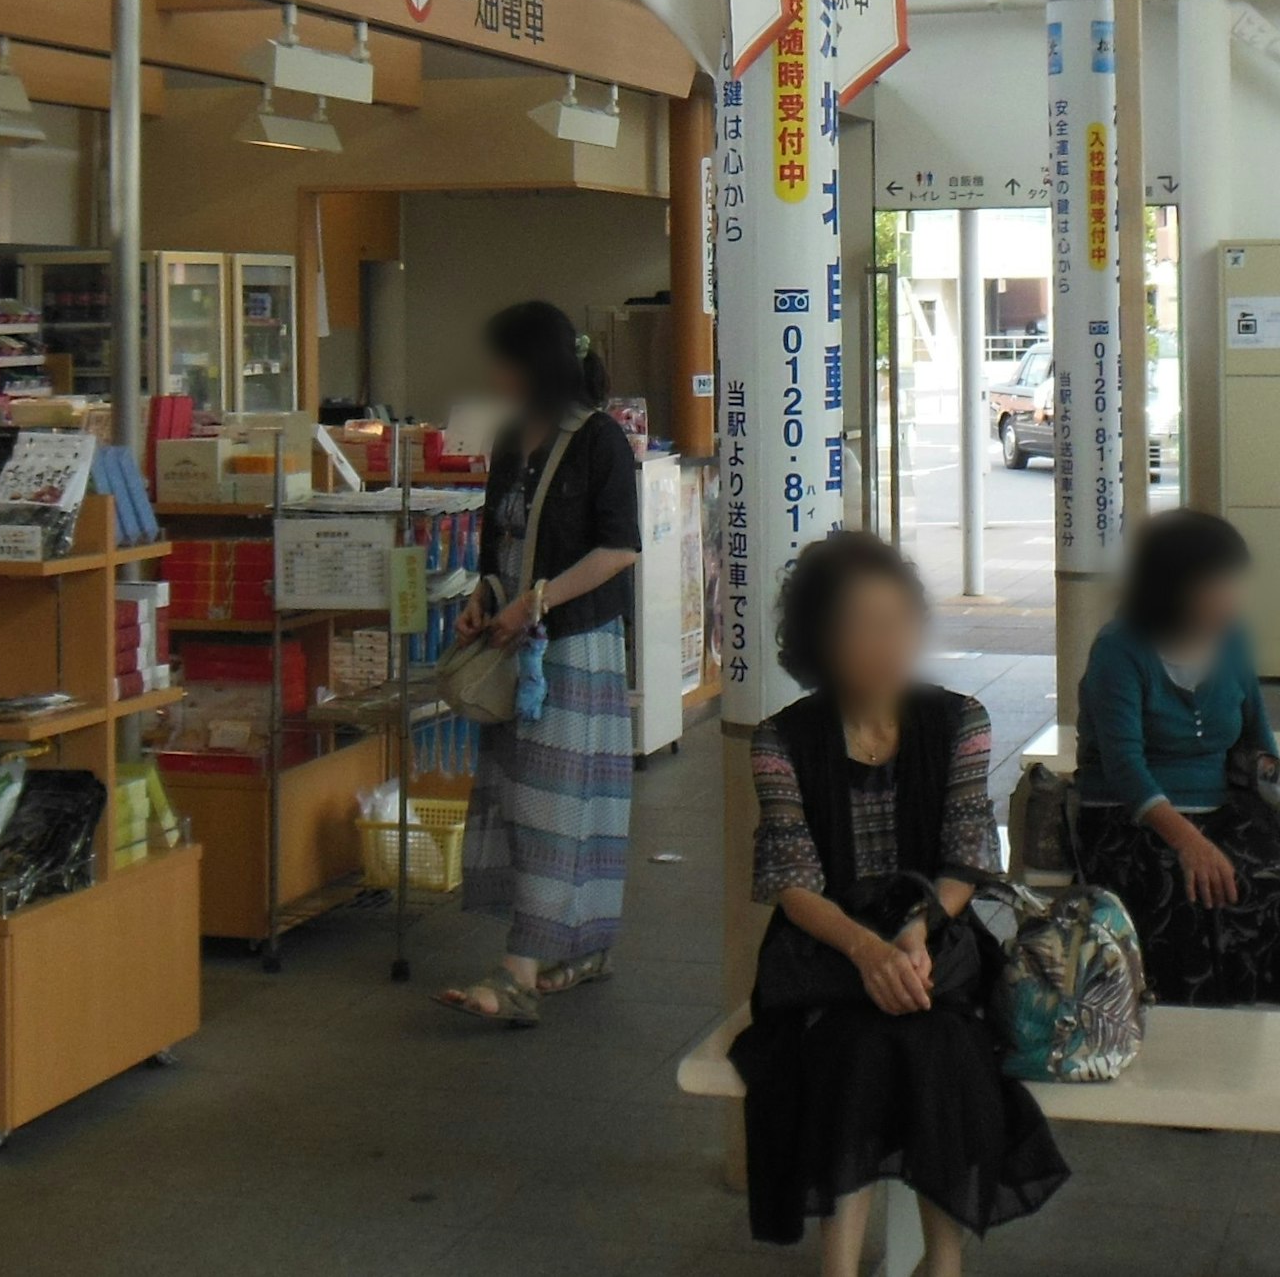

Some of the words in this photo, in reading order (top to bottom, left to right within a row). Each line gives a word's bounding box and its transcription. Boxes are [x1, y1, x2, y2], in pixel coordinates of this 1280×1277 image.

[909, 190, 940, 202] トイレ
[1028, 188, 1049, 200] タク
[726, 380, 748, 682] 当駅より送迎車で3分
